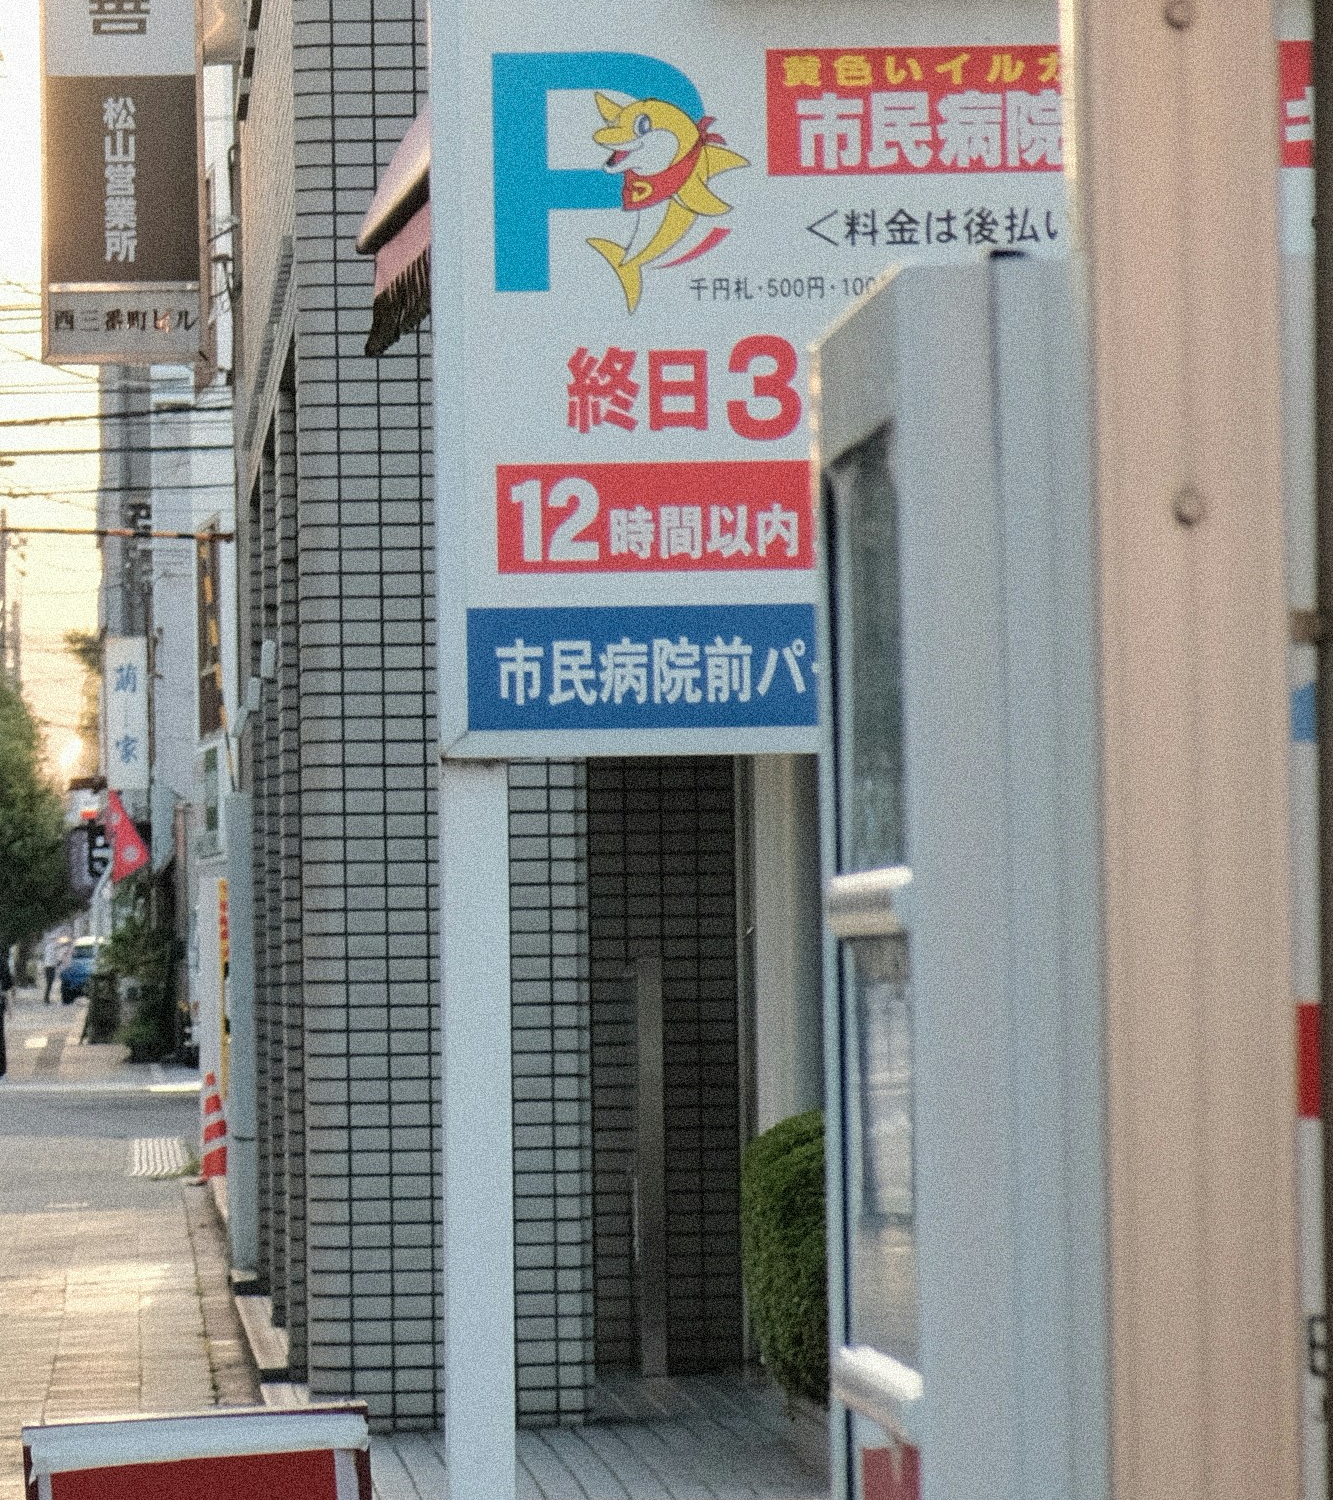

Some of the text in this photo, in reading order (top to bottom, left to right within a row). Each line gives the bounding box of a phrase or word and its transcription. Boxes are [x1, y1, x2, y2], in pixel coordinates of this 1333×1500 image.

[492, 50, 710, 292] P
[796, 90, 1062, 169] 市民病院
[103, 97, 137, 263] 松山営業所
[54, 308, 198, 333] 西三番町ビル
[566, 334, 801, 440] 終日3
[509, 479, 813, 563] 12時間以内
[495, 637, 817, 708] 市民病院前パ
